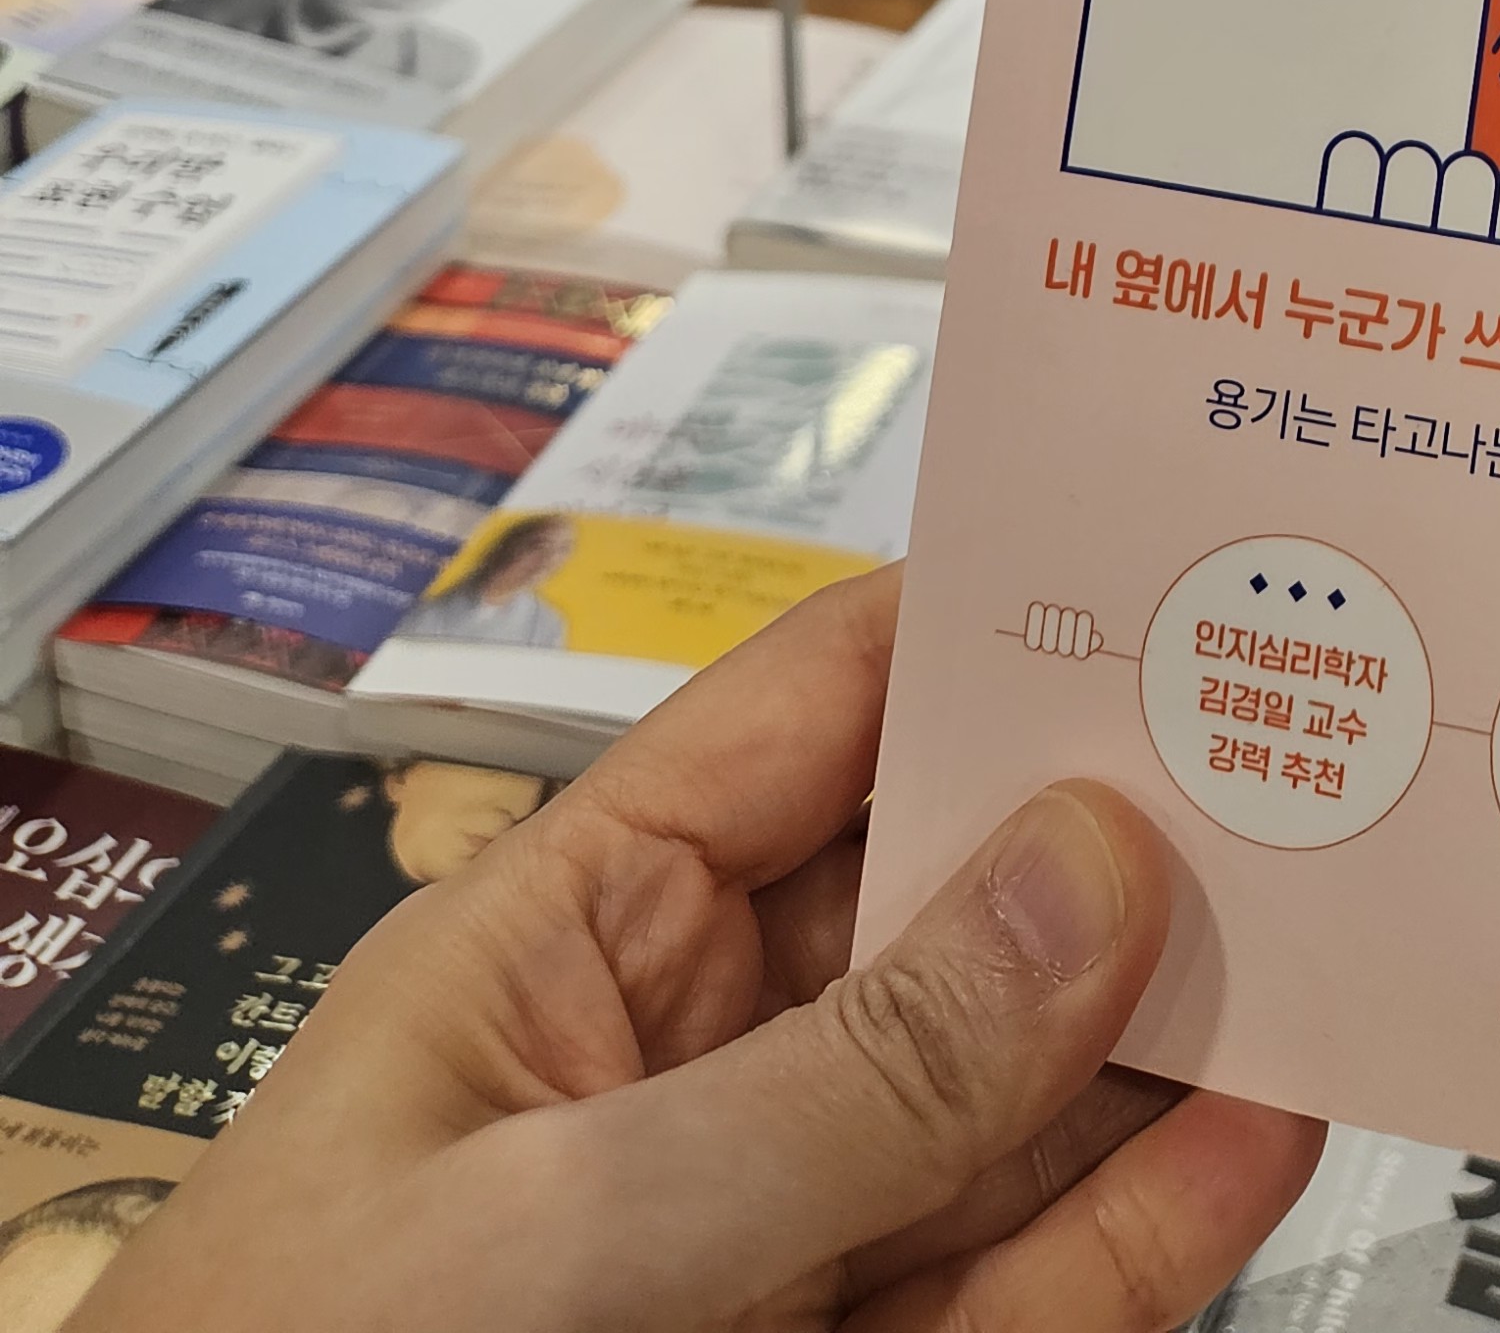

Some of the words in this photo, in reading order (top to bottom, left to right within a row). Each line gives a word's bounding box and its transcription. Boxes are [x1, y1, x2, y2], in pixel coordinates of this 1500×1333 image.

[1045, 238, 1096, 299] 내
[1112, 249, 1268, 330] 옆에서
[1285, 279, 1446, 361] 누군가
[1205, 378, 1337, 447] 용기는
[1194, 619, 1388, 694] 인지심리학자
[1199, 676, 1294, 731] 김경일
[1303, 699, 1368, 746] 교수
[1208, 734, 1271, 782] 강력
[1281, 751, 1346, 800] 추천
